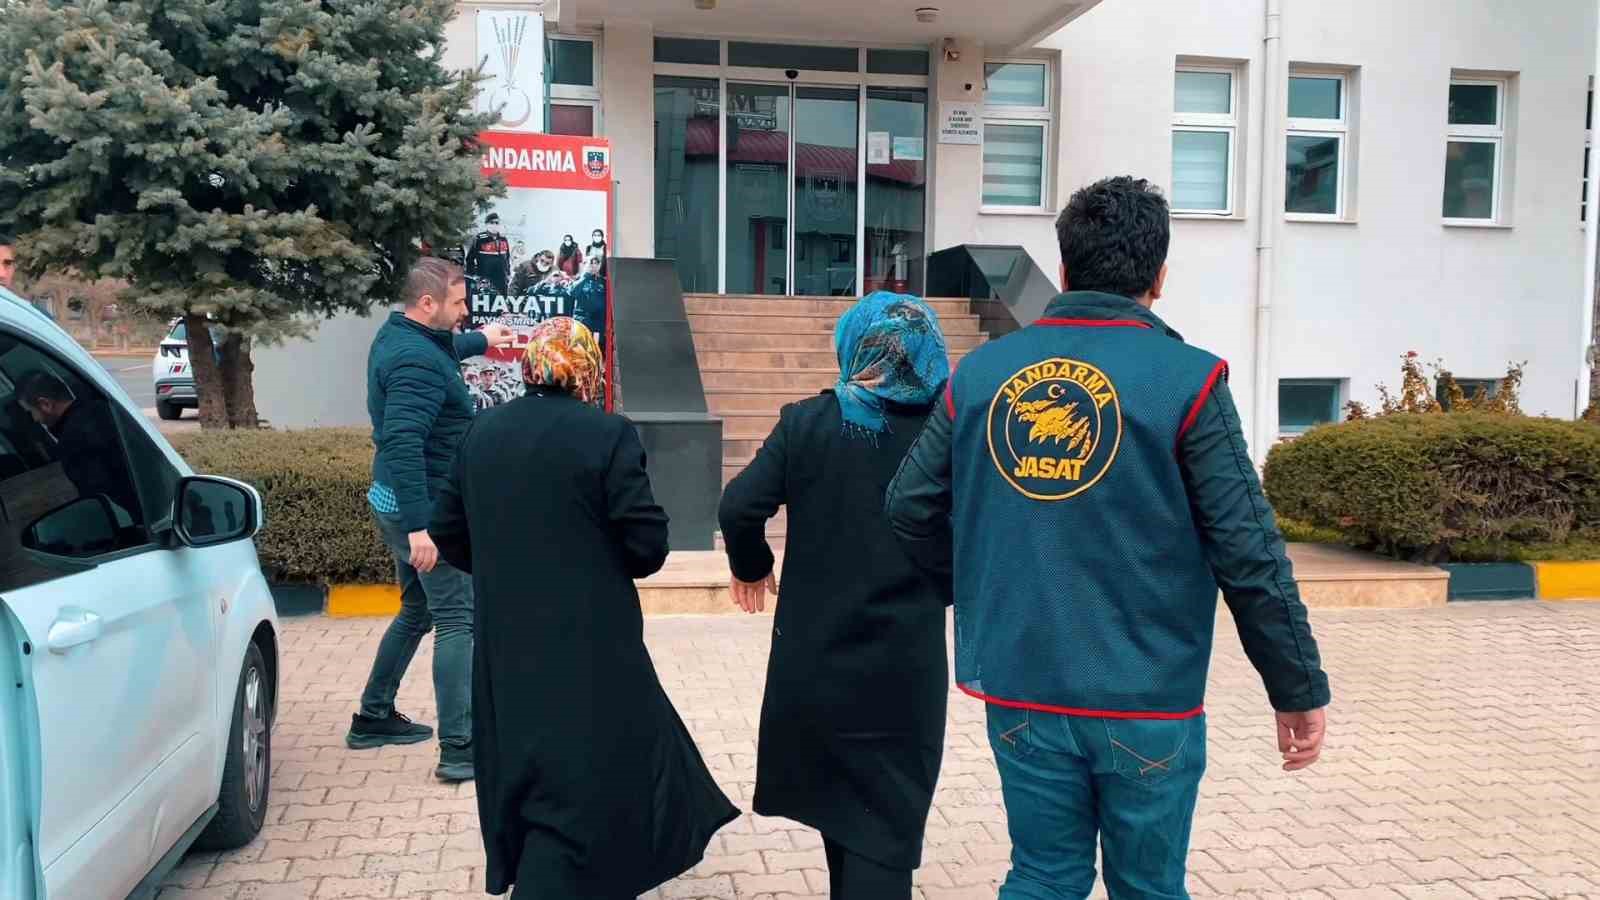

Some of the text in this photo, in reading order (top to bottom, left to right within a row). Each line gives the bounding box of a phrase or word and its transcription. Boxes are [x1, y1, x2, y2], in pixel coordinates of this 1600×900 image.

[471, 294, 564, 314] HAYATI
[1003, 362, 1113, 409] JANDARMA
[1013, 456, 1085, 481] JASAT
